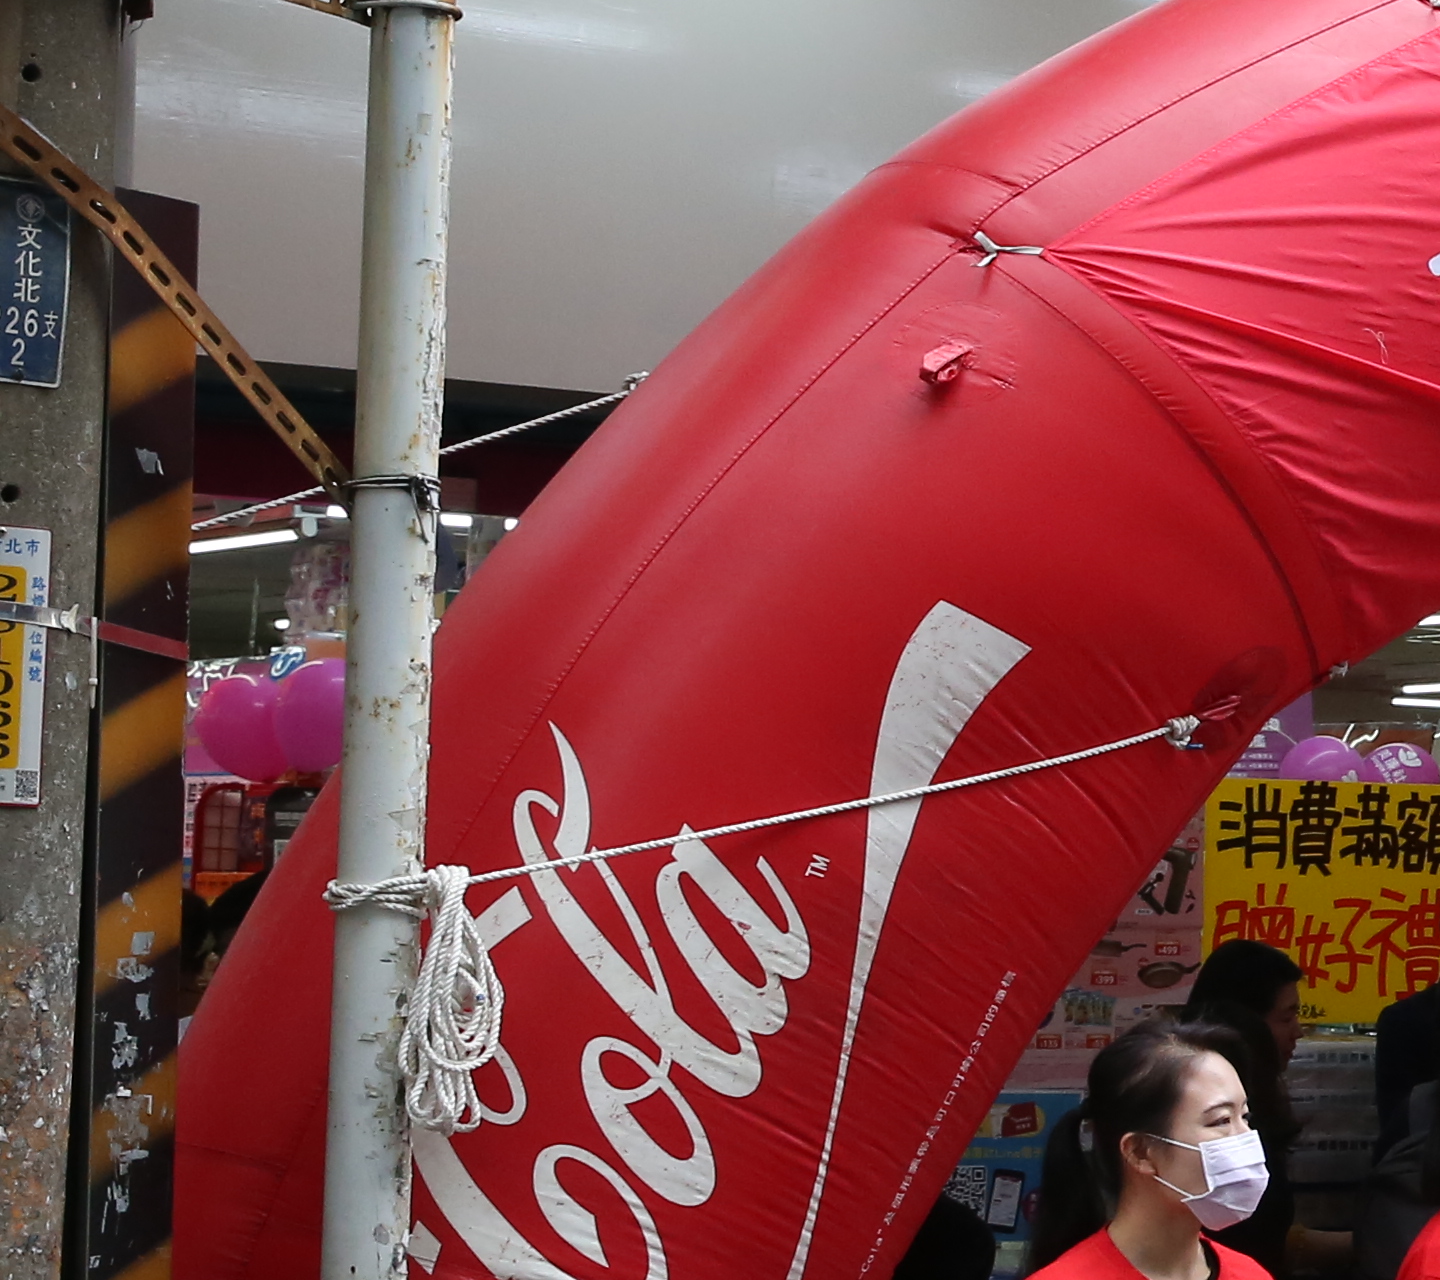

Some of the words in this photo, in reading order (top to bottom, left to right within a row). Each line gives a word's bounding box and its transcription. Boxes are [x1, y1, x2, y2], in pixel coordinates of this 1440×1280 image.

[13, 223, 43, 304] 文化北
[0, 538, 41, 557] 北市
